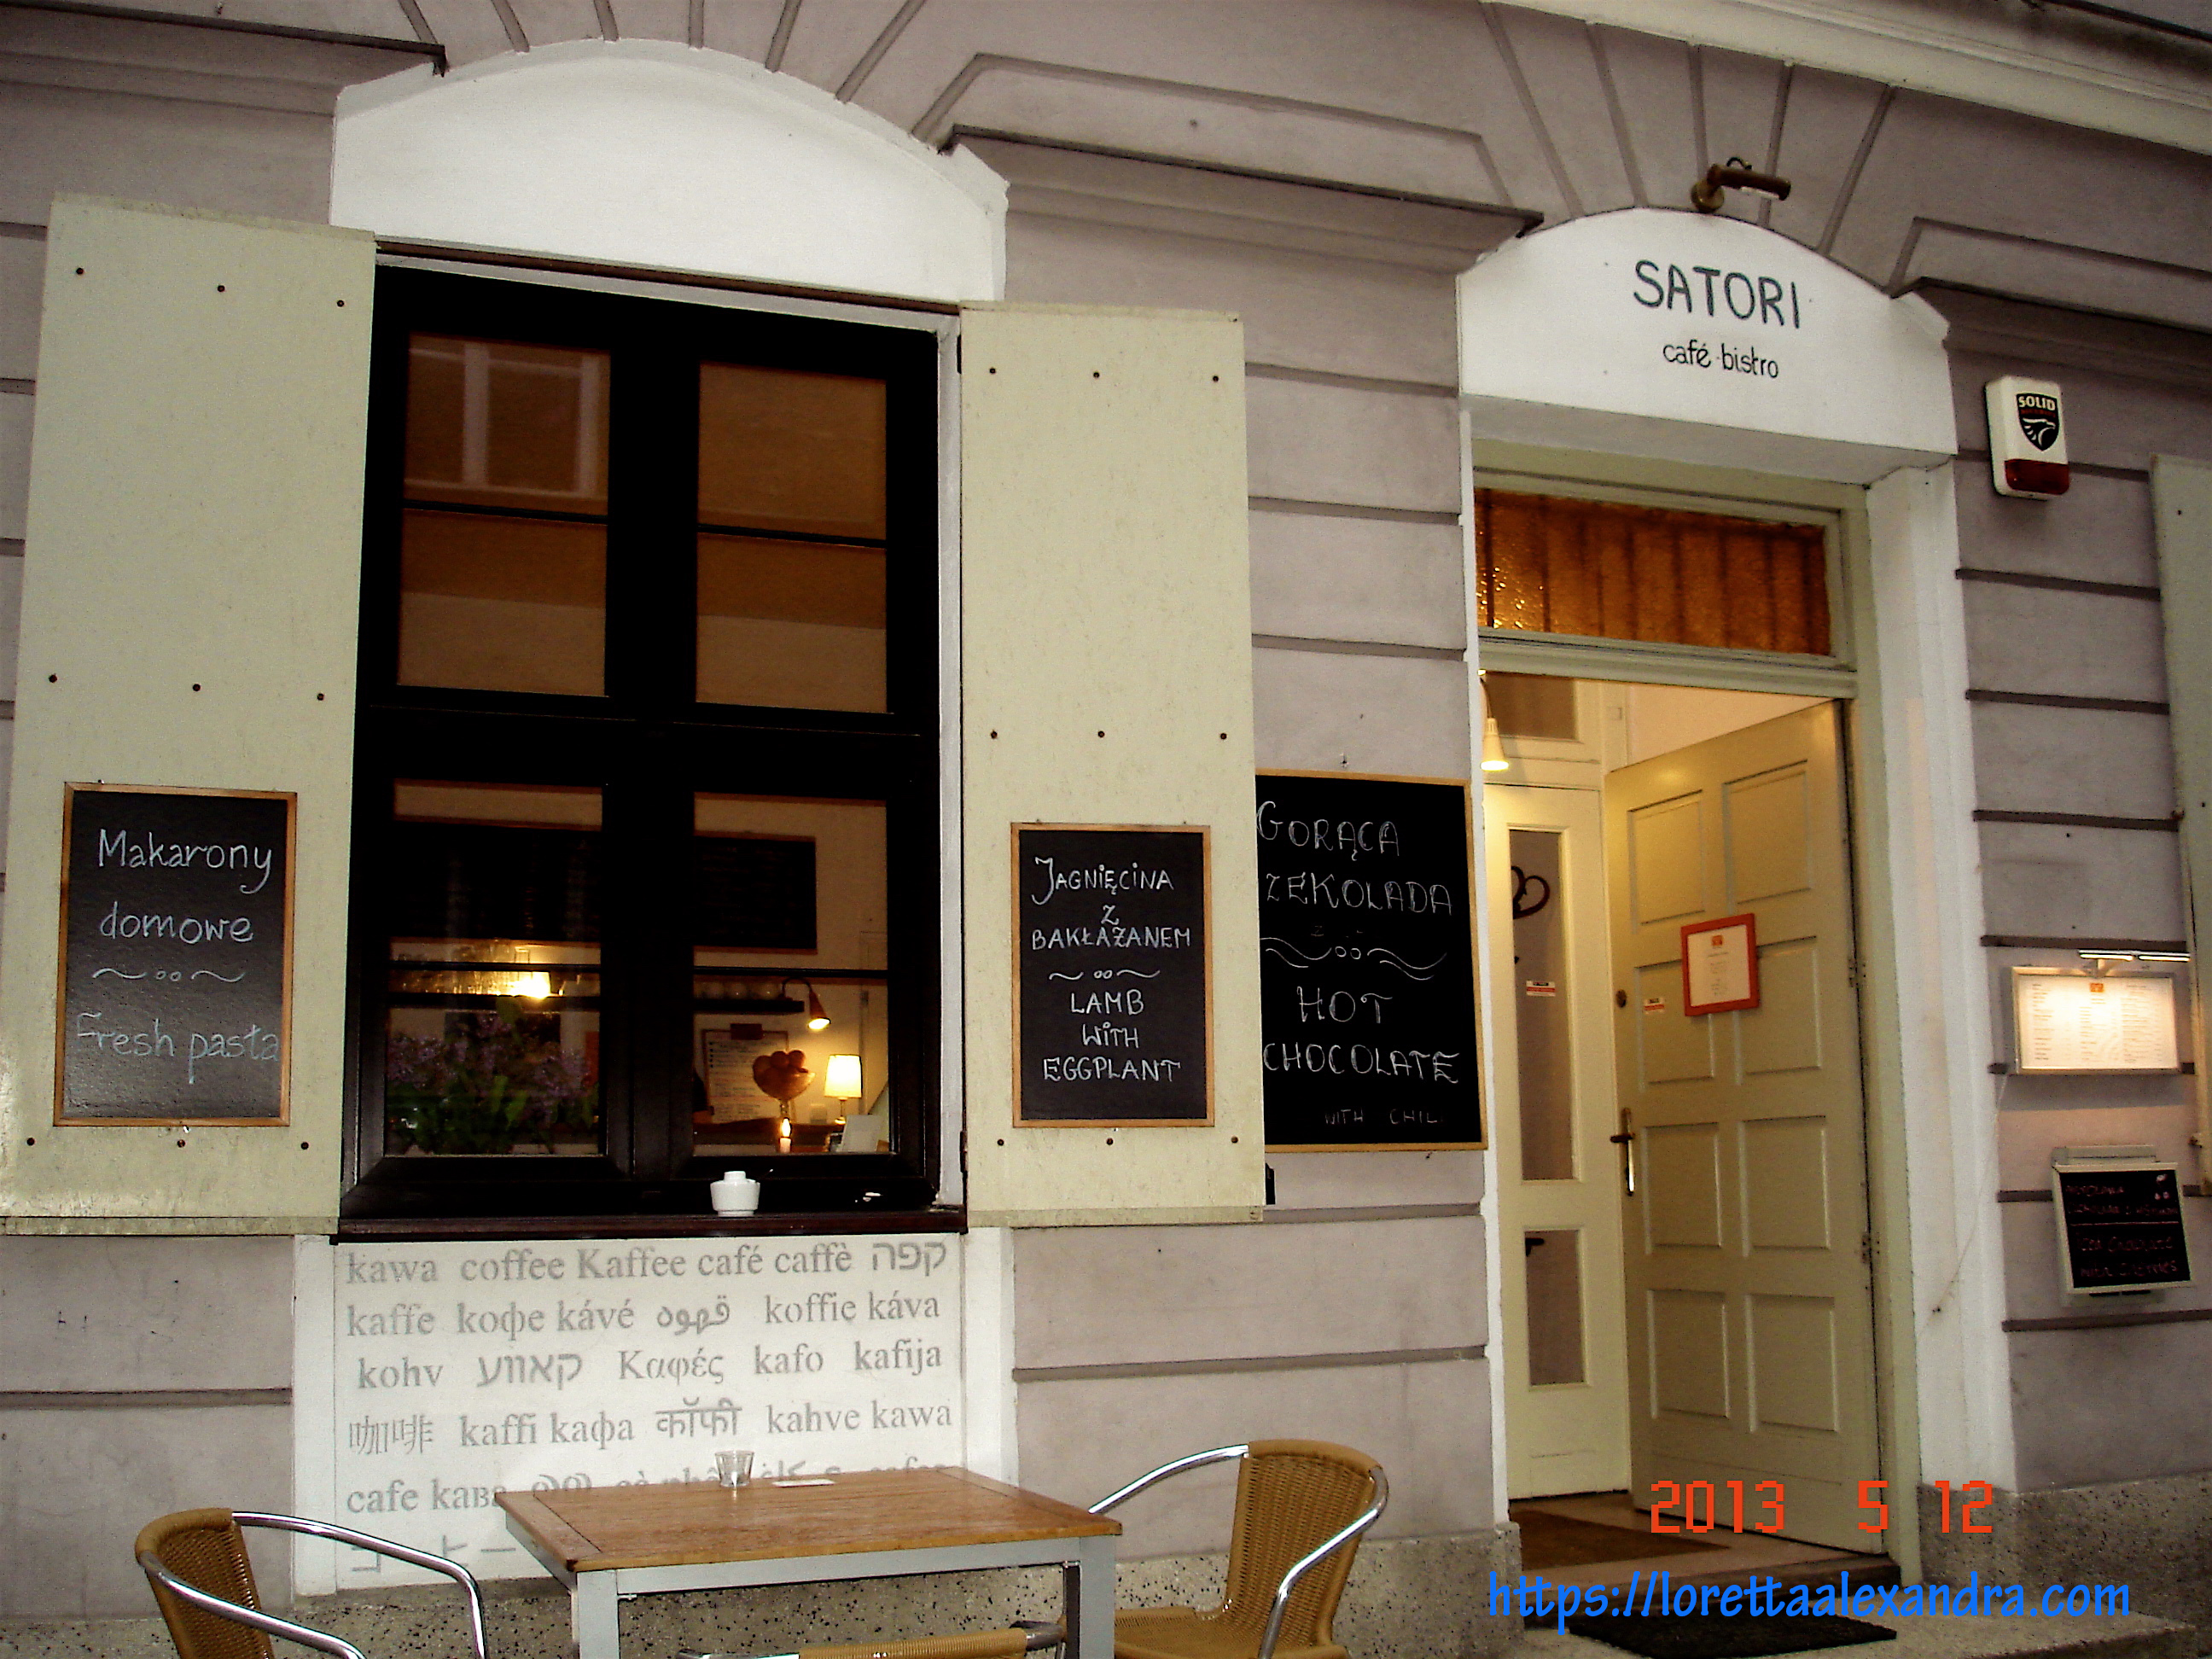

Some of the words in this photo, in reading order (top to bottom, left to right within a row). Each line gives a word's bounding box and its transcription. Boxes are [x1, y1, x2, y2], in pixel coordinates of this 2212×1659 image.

[1633, 259, 1801, 329] SATORI
[1662, 340, 1712, 370] café
[1720, 343, 1779, 380] bistro
[2018, 395, 2056, 410] SOLID
[1256, 800, 1400, 861] GORĄCA
[98, 828, 272, 894] Makarony
[100, 900, 254, 945] domowe
[1070, 988, 1144, 1016] LAMB
[1296, 986, 1393, 1024] HOT
[77, 1011, 175, 1057] Fresh
[188, 1024, 280, 1085] pasta
[1263, 1043, 1460, 1084] CHOCOLATE
[1043, 1057, 1181, 1083] EGGPLANT
[1324, 1108, 1364, 1125] WITH
[347, 1251, 438, 1284] kawa
[461, 1248, 565, 1281] coffee
[577, 1245, 686, 1279] Kaffee
[698, 1244, 764, 1276] café
[775, 1243, 852, 1274] caffè
[872, 1242, 947, 1277] קפה
[347, 1303, 435, 1336] kaffe
[556, 1298, 634, 1331] kávé
[764, 1291, 857, 1324] koffie
[868, 1289, 940, 1320] káva
[358, 1357, 444, 1388] kohv
[754, 1342, 824, 1375] kafo
[854, 1338, 942, 1376] kafija
[349, 1415, 434, 1454] 咖啡
[459, 1413, 537, 1447] kaffi
[767, 1402, 860, 1434] kahve
[871, 1400, 952, 1429] kawa
[346, 1480, 419, 1513] cafe
